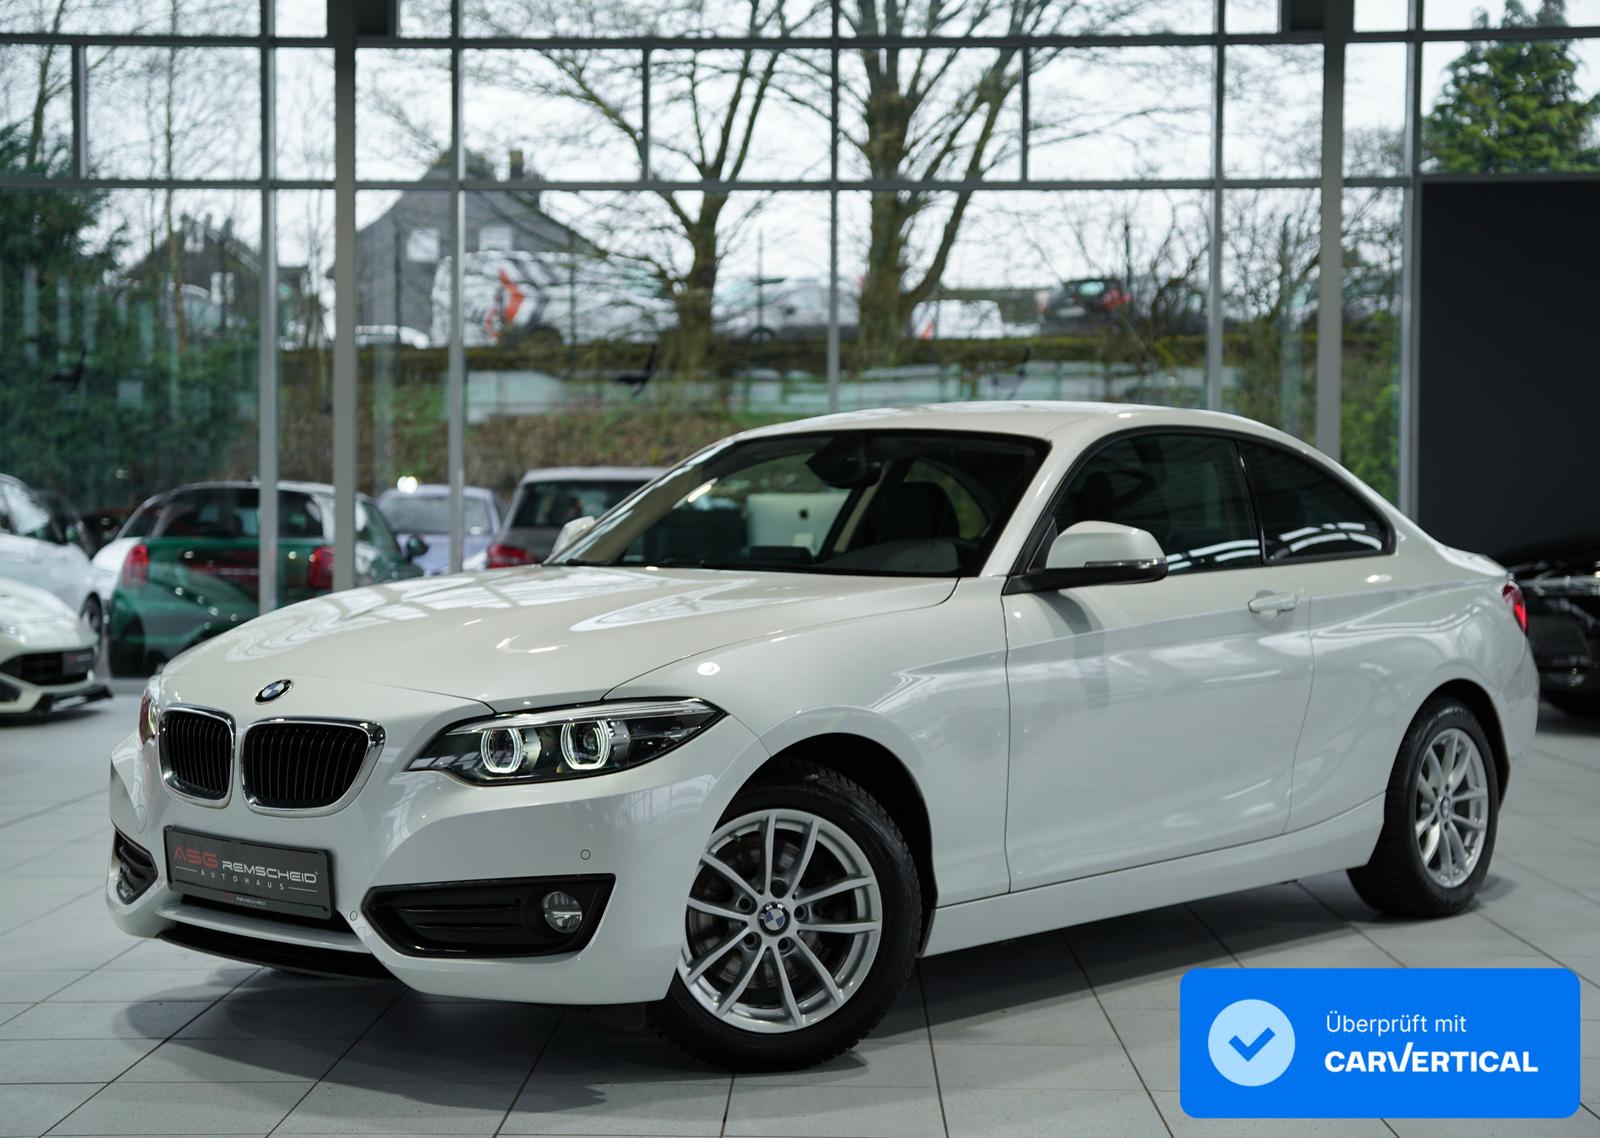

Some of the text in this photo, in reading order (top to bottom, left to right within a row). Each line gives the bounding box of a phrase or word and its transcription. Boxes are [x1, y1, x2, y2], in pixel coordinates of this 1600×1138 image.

[173, 845, 317, 884] ASG REMSCHEID
[201, 870, 285, 890] AUTOHAUS
